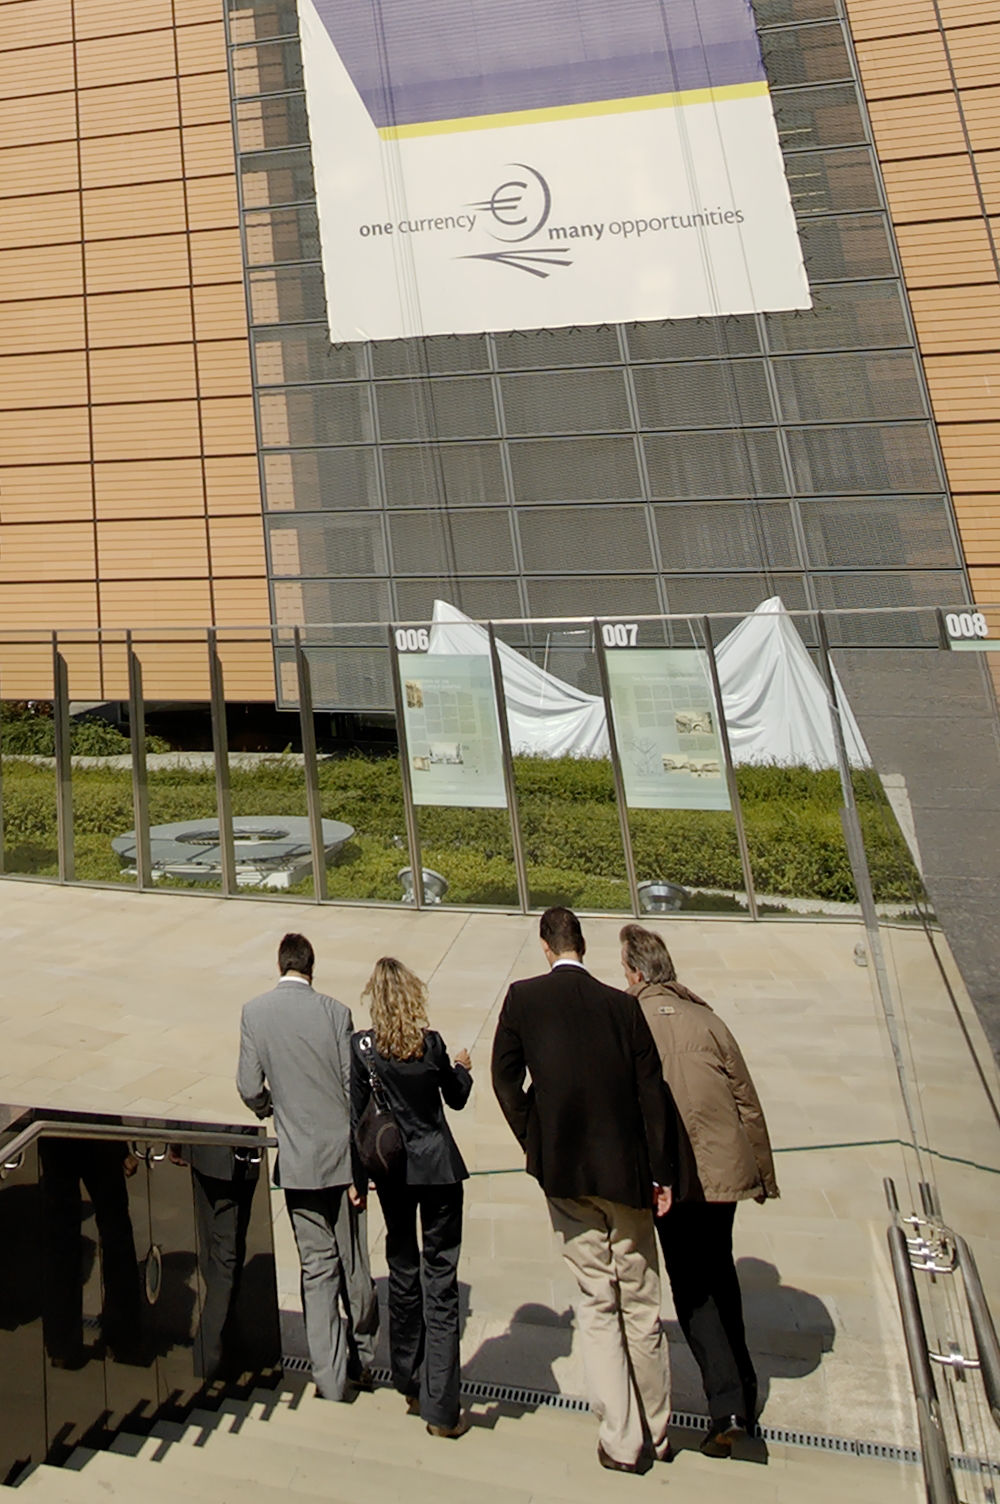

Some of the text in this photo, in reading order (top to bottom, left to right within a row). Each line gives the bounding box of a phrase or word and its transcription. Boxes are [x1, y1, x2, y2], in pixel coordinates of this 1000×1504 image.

[359, 223, 394, 238] one
[398, 214, 477, 234] currency
[548, 224, 605, 241] many
[608, 206, 745, 239] opportunities
[602, 623, 638, 647] 007
[945, 612, 989, 638] 008
[395, 628, 429, 651] 006
